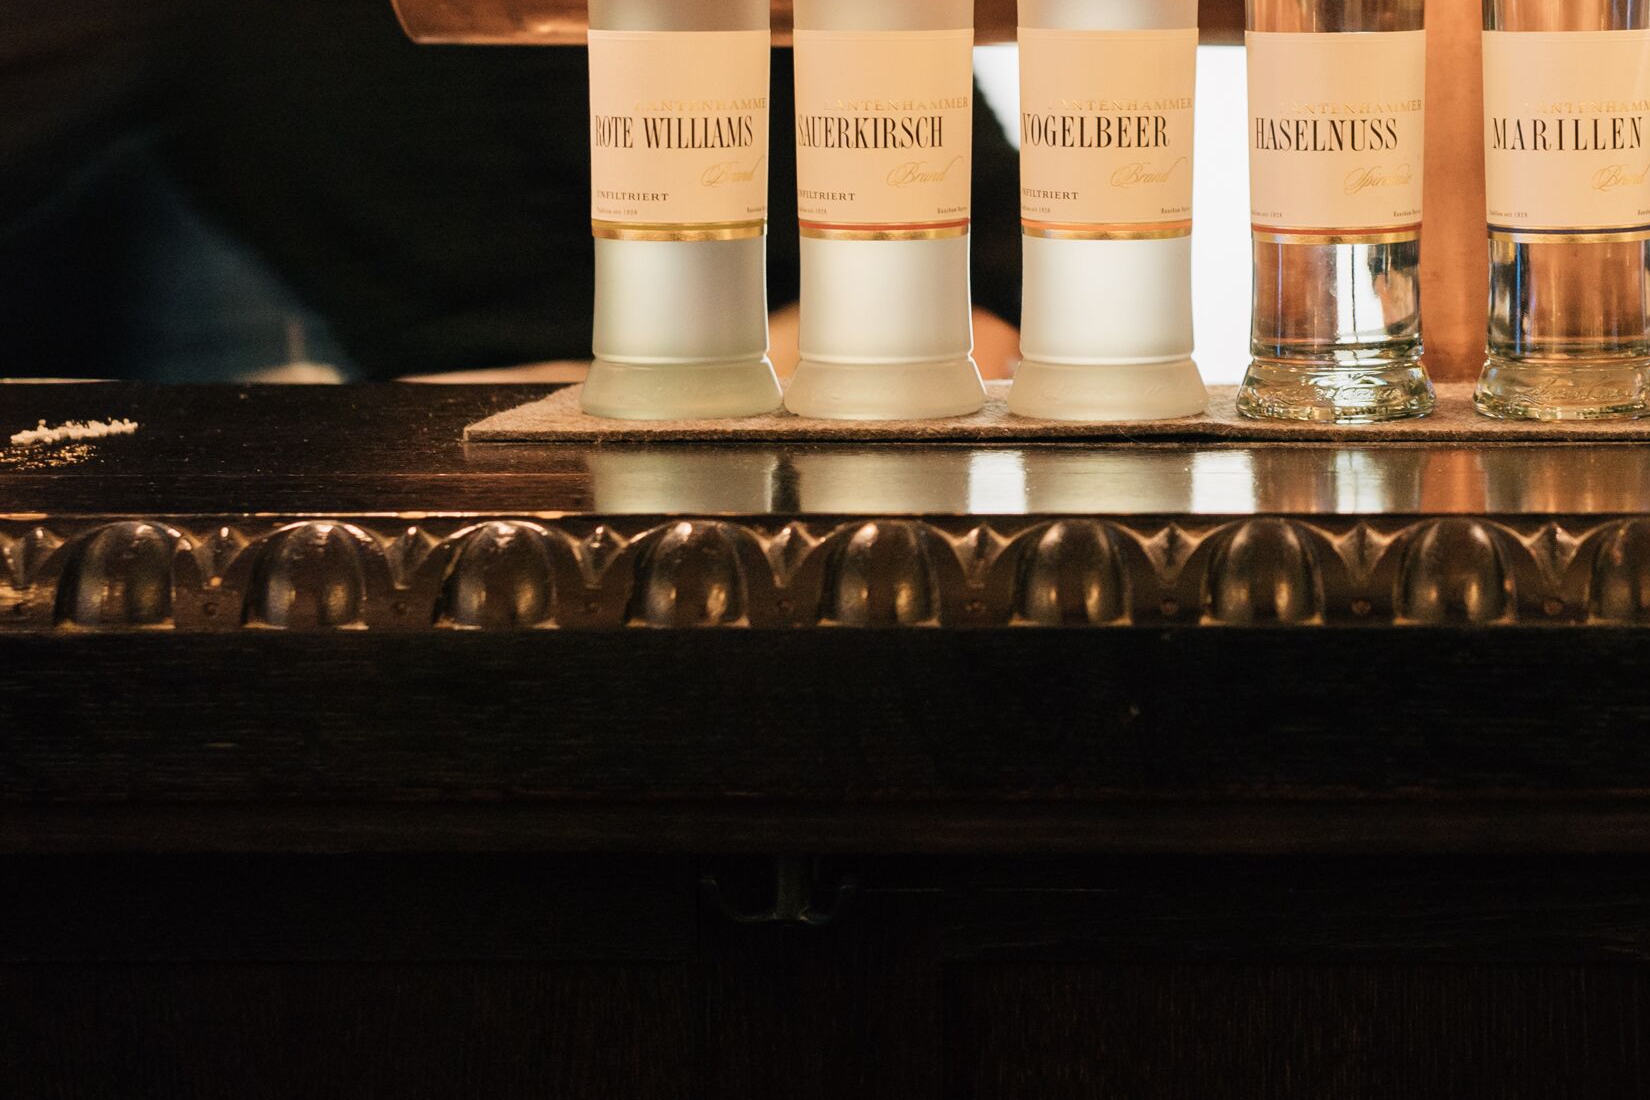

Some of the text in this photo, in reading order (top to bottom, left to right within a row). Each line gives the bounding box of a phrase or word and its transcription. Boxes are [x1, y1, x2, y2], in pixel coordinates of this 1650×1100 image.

[595, 115, 753, 149] ROTE WILLIAMS
[798, 114, 944, 149] SAUERKIRSCH
[1022, 112, 1170, 149] VOGELBEER
[1255, 117, 1398, 152] HASELNUSS
[1493, 116, 1643, 151] MARILLEN
